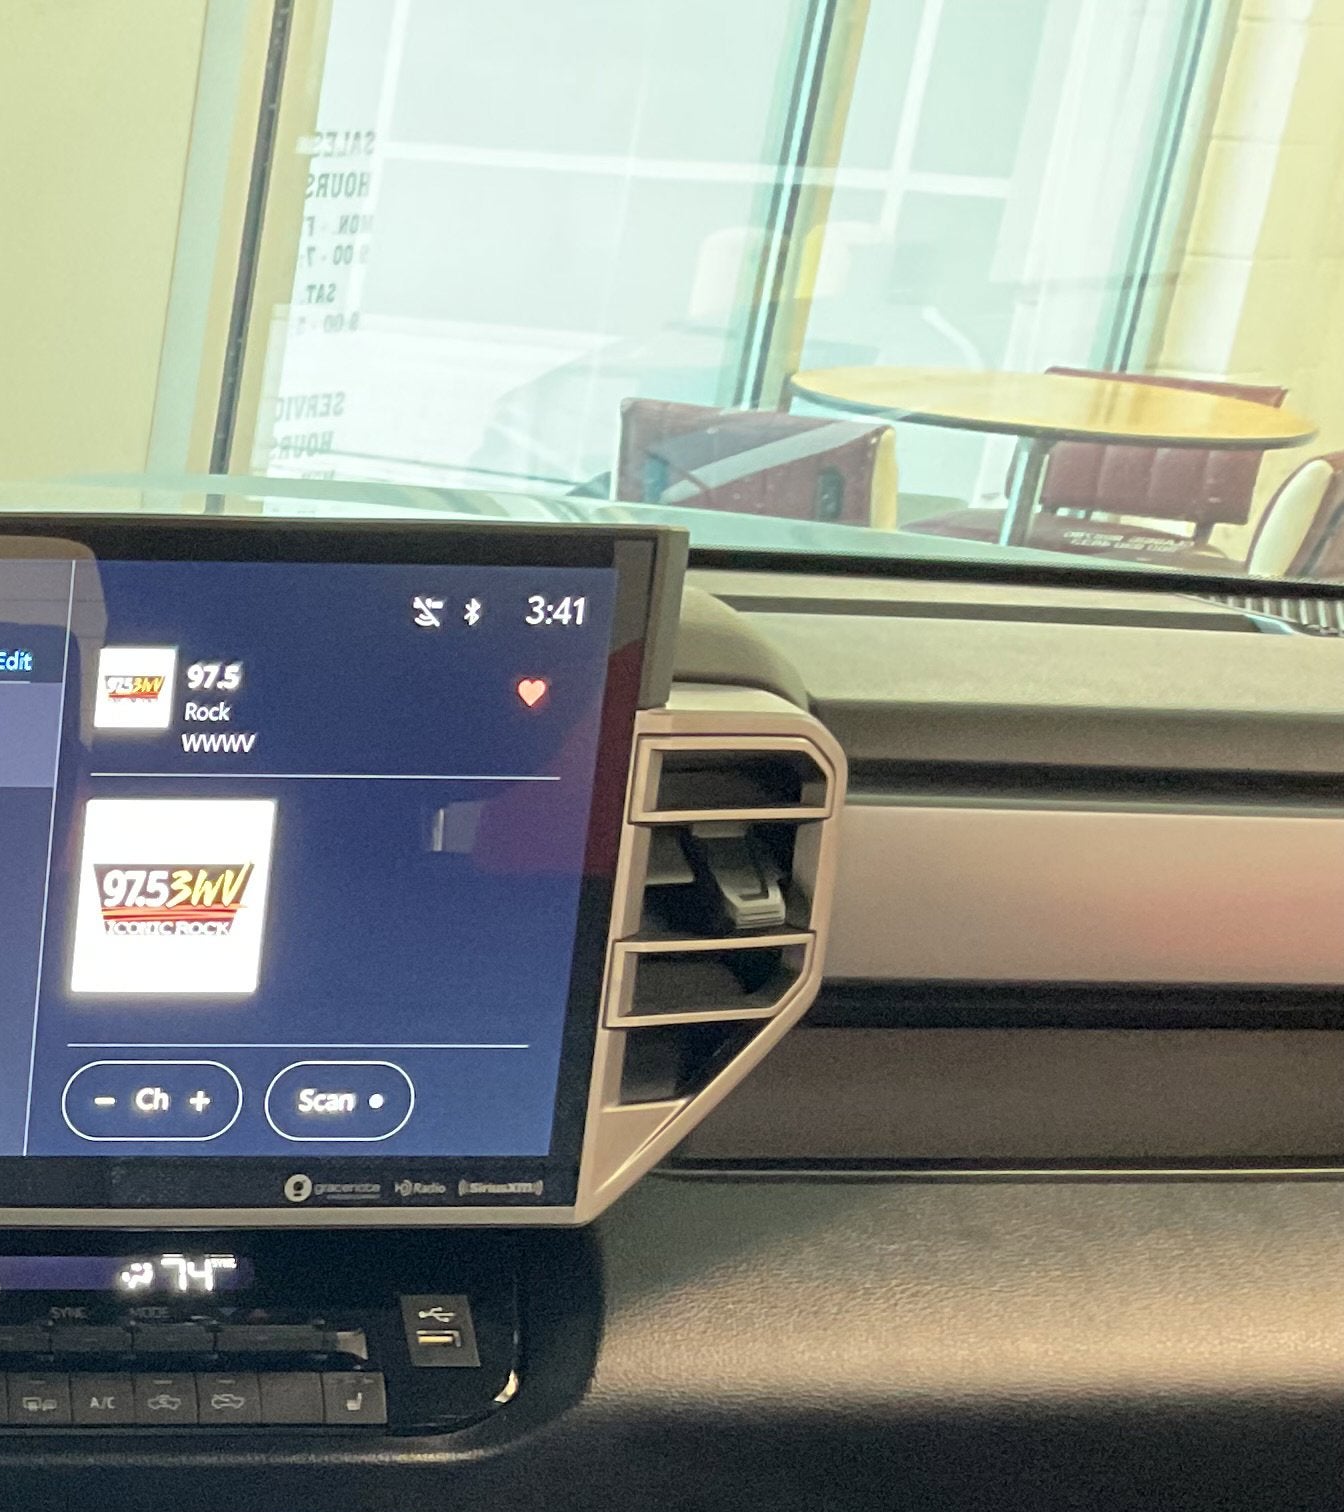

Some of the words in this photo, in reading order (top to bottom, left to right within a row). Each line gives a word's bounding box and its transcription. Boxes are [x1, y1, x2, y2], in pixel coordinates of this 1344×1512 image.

[524, 595, 587, 627] 3:41
[186, 663, 242, 690] 97.5
[185, 701, 232, 722] Rock
[174, 920, 231, 936] ROCK
[135, 1087, 169, 1111] Ch
[298, 1087, 356, 1112] Scan
[412, 1182, 447, 1195] Radio
[160, 1257, 214, 1291] 74
[49, 1306, 87, 1319] SYNC
[89, 1396, 116, 1409] A/C
